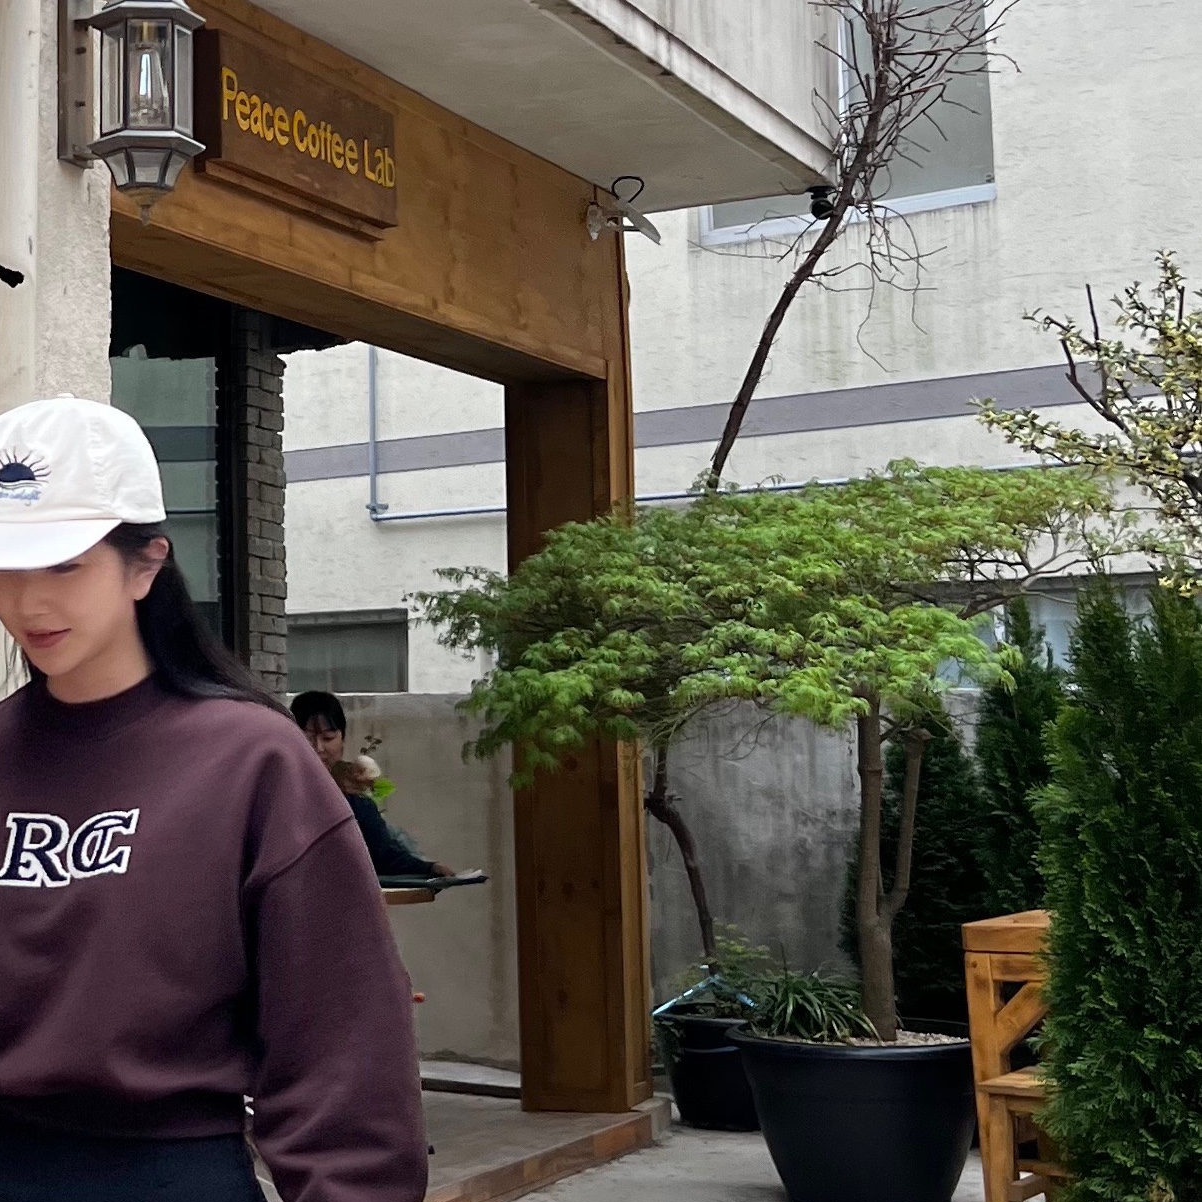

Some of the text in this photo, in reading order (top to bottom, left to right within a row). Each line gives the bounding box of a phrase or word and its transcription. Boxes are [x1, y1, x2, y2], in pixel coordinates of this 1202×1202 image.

[221, 66, 396, 189] Peace Coffee Lab
